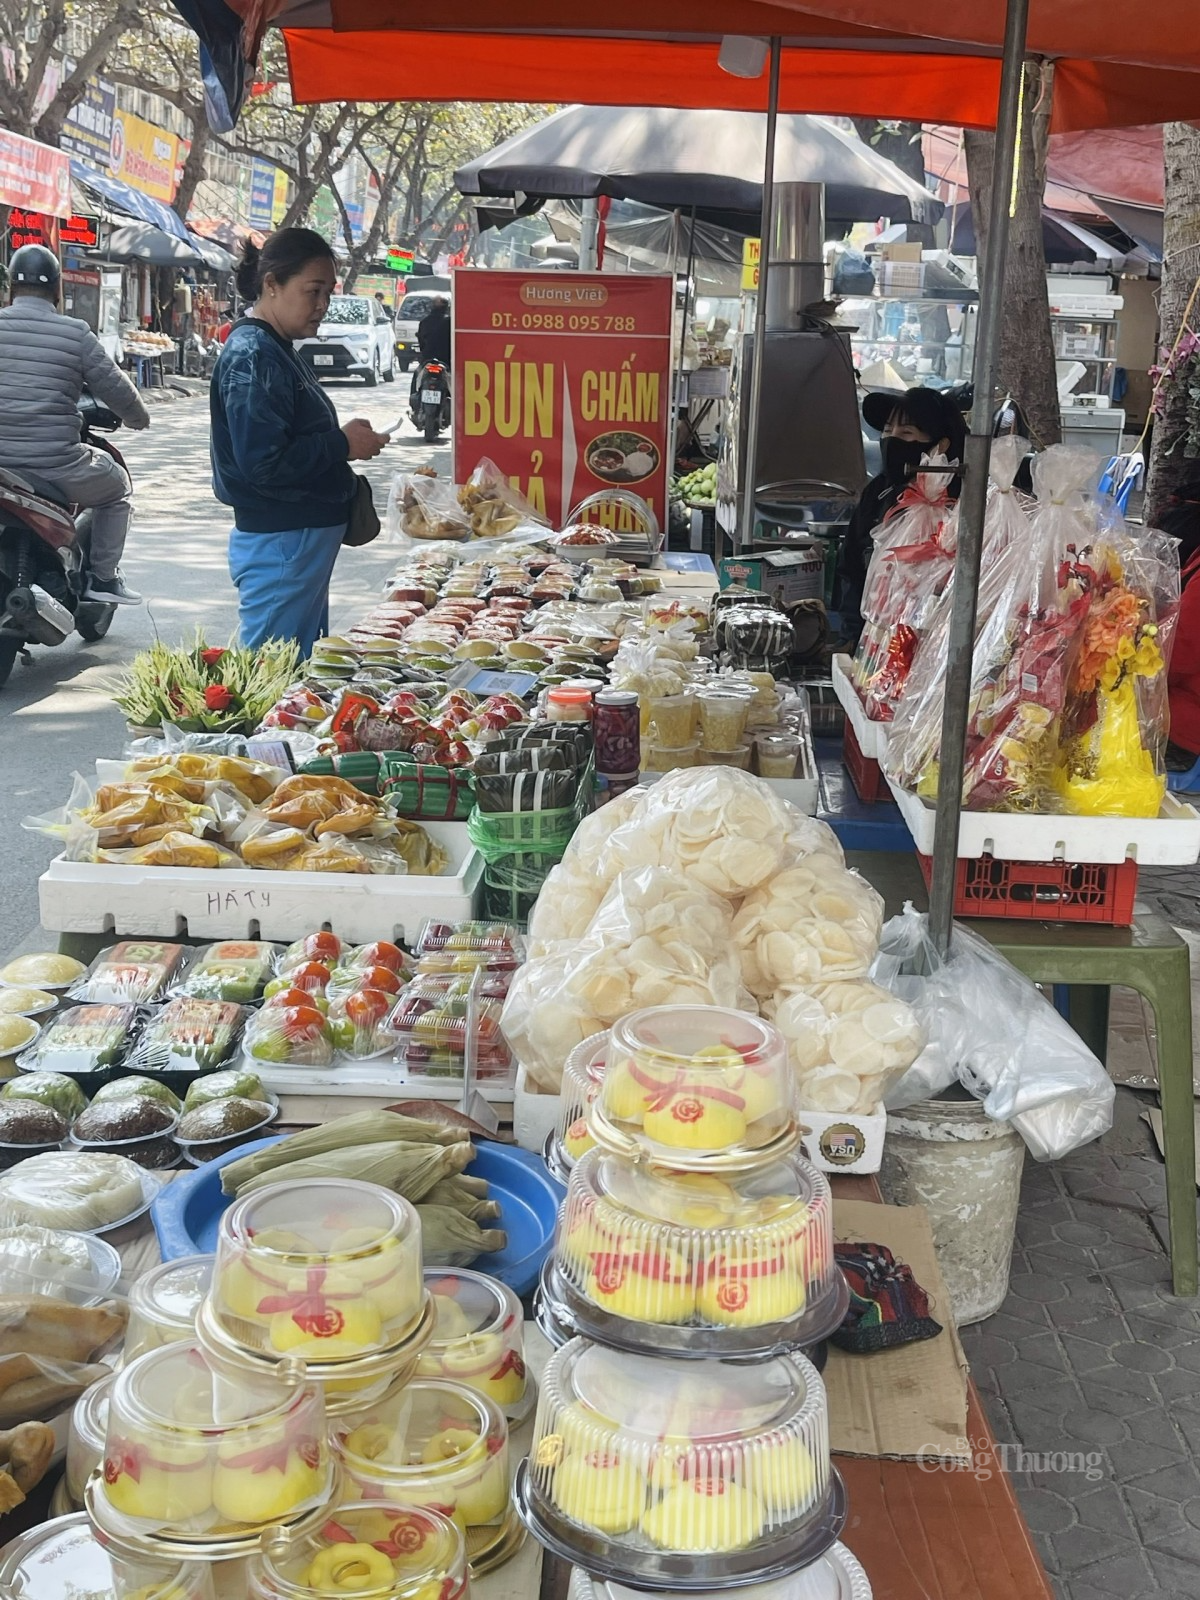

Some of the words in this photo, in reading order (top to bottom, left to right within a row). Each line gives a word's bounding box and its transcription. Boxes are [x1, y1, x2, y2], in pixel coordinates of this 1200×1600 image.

[526, 286, 572, 303] Hương
[575, 287, 603, 303] Việt
[491, 312, 517, 328] ĐT:
[522, 313, 565, 329] 0988
[569, 315, 600, 330] 095
[604, 316, 636, 331] 788
[464, 344, 554, 439] BÚN
[580, 353, 660, 423] CHẤM
[830, 1144, 855, 1154] USA
